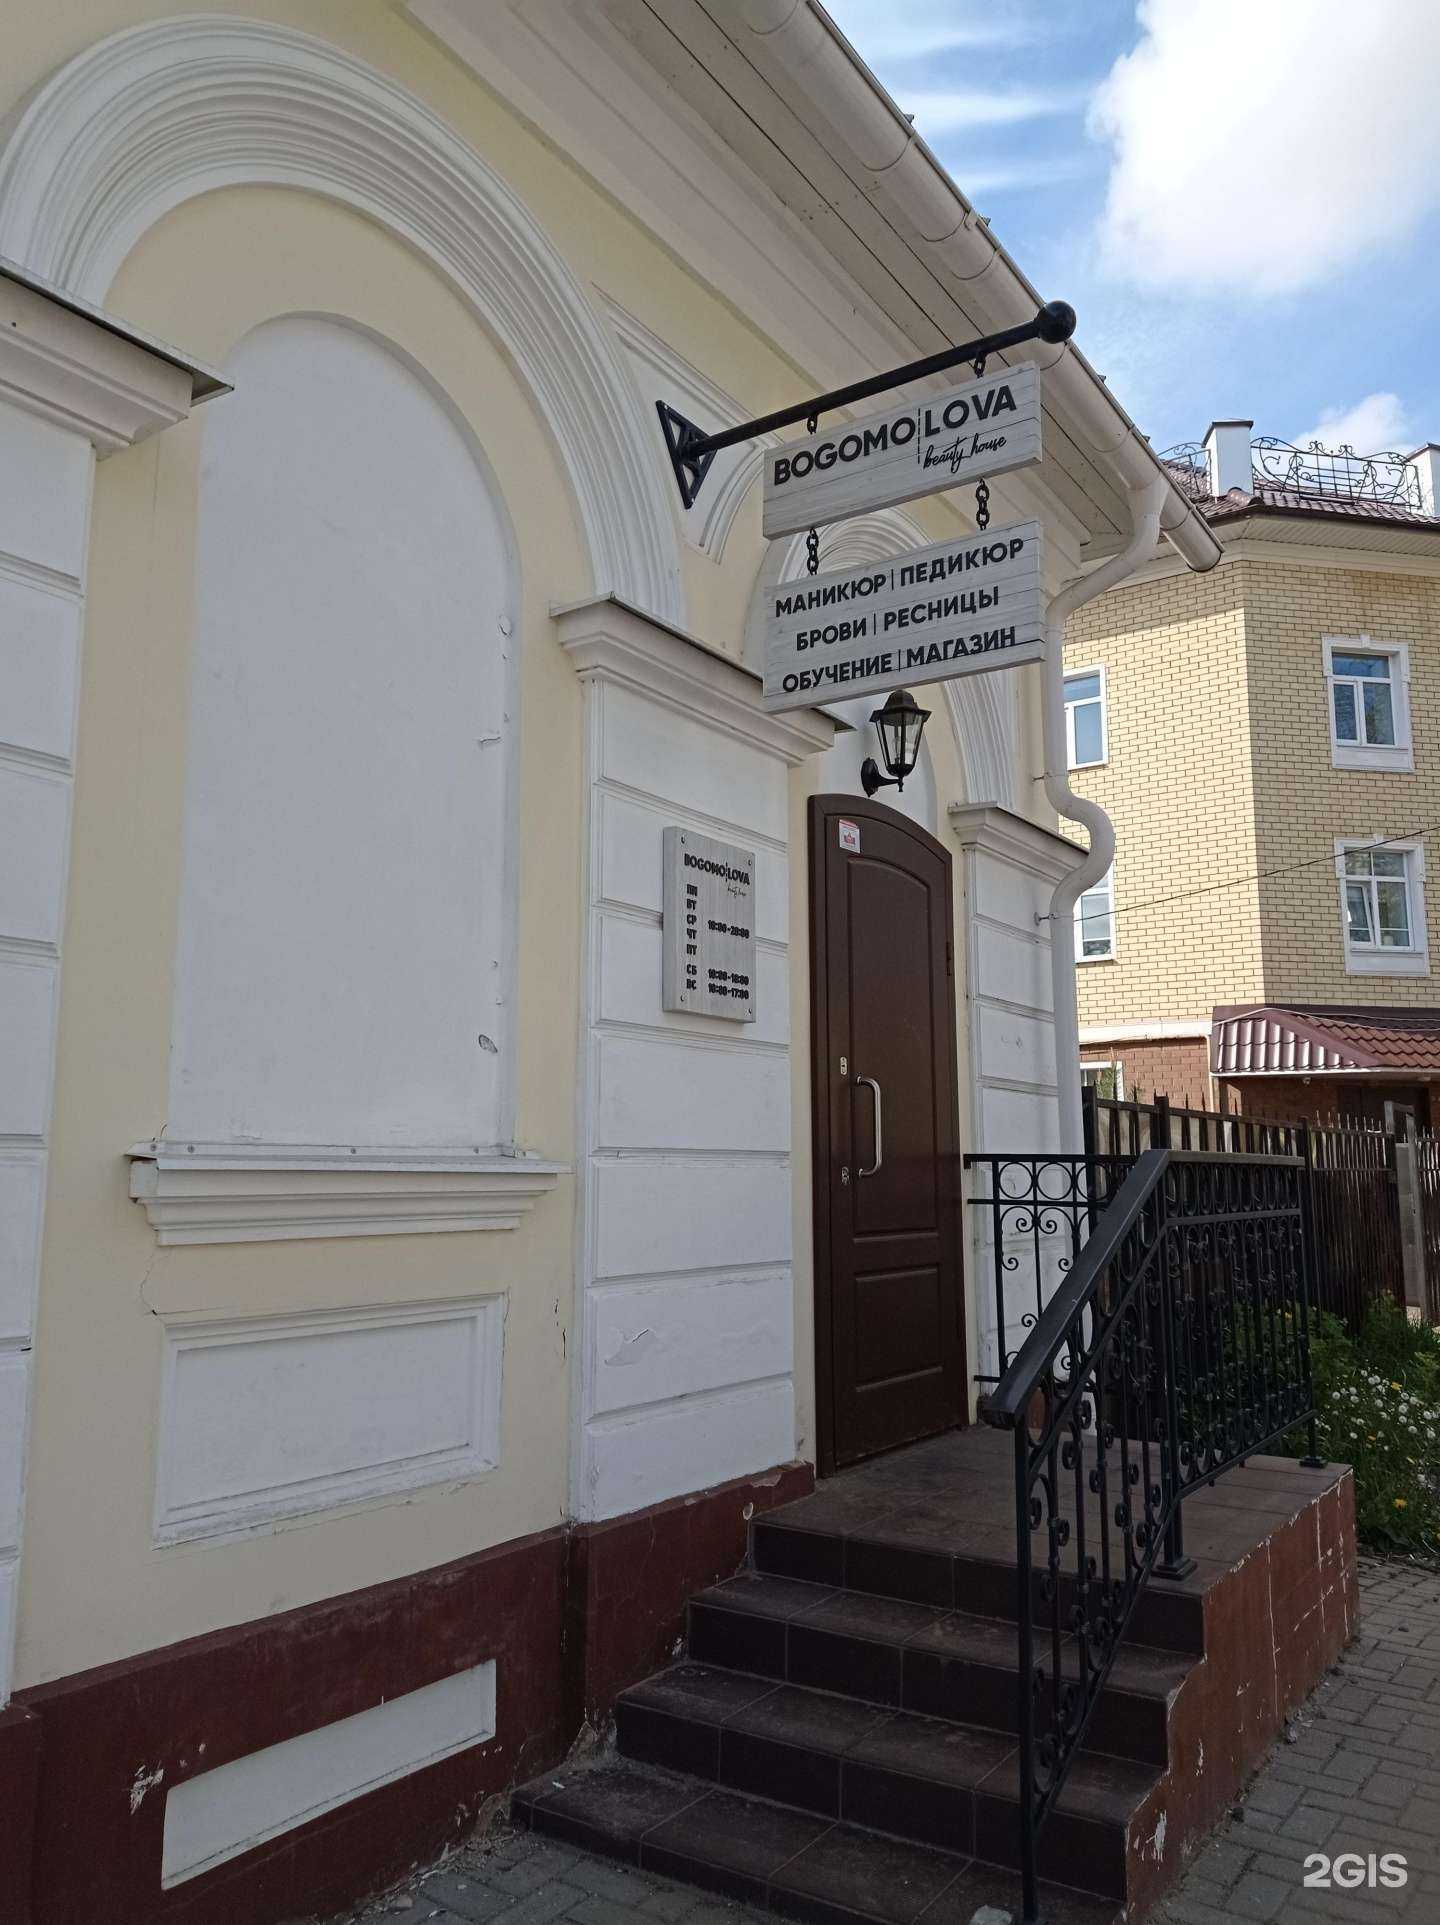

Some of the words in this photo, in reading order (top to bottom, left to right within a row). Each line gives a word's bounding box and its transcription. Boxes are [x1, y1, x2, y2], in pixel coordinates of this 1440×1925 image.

[923, 436, 964, 473] beauty
[970, 433, 1007, 462] house
[775, 574, 887, 618] МАНИКЮР
[900, 538, 1025, 587] ПЕДИКЮР
[796, 616, 867, 651] БРОВИ
[884, 586, 1000, 631] РЕСНИЦЫ
[782, 652, 893, 693] ОБУЧЕНИЕ
[906, 626, 1016, 668] МАГАЗИН
